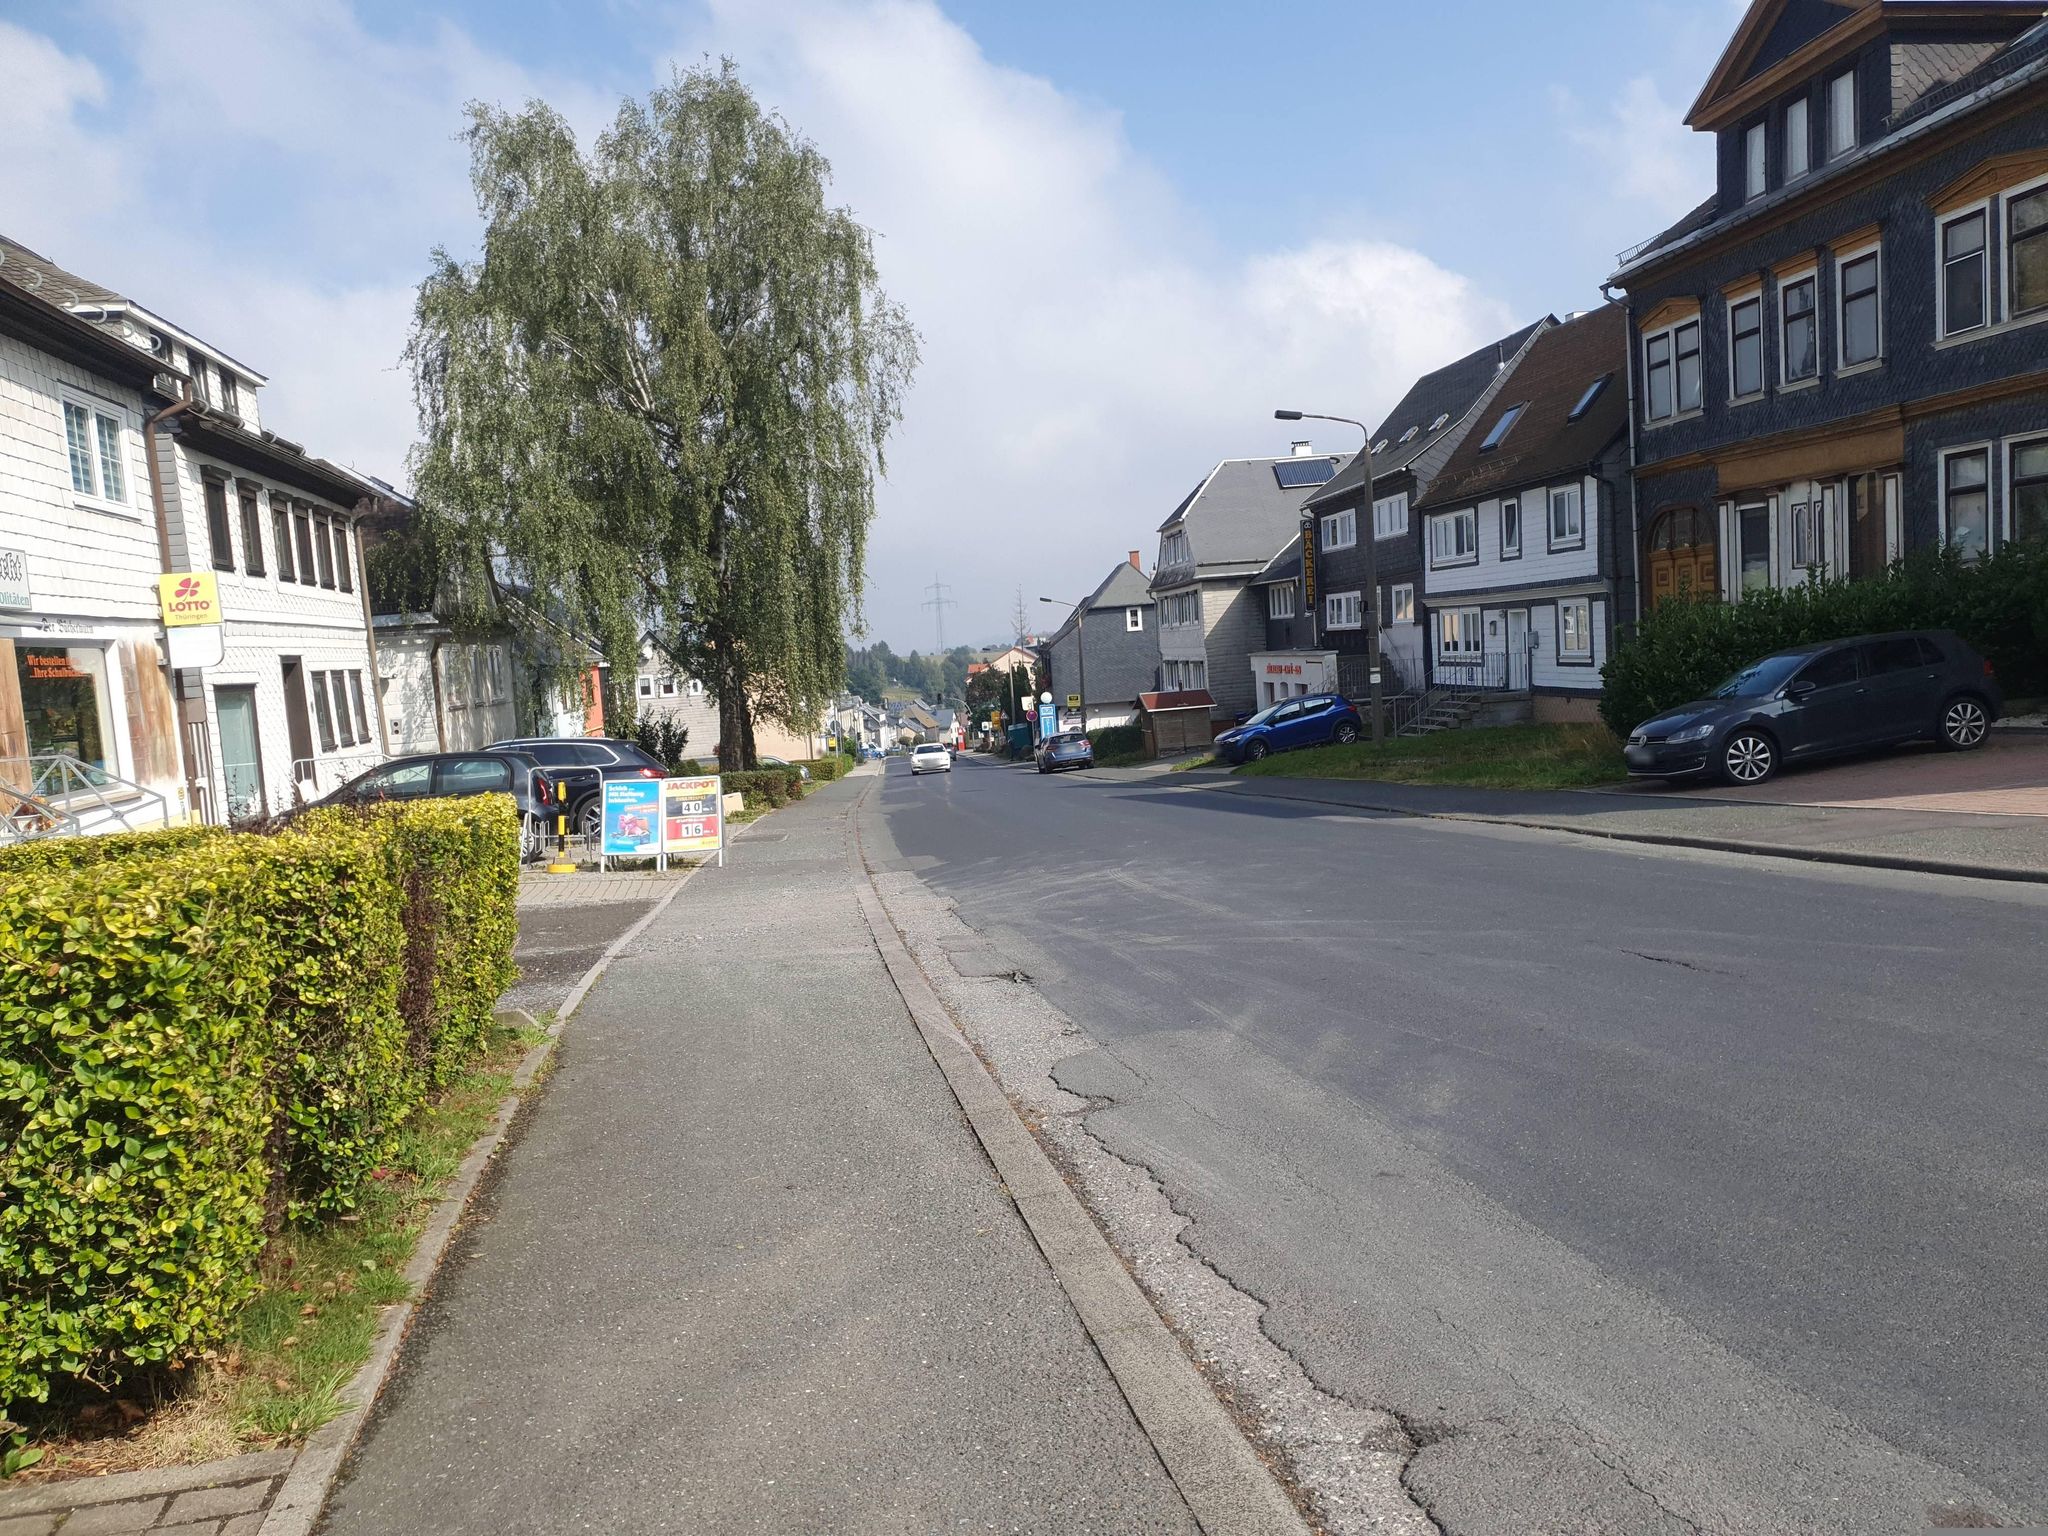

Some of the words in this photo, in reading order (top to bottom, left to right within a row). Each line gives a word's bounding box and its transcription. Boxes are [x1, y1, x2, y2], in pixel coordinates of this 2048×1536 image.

[0, 552, 22, 582] rkt
[1304, 529, 1315, 604] BÄCKEREI
[168, 600, 210, 612] LOTTO
[175, 613, 208, 621] Thüringen
[666, 781, 717, 790] JACKPOT
